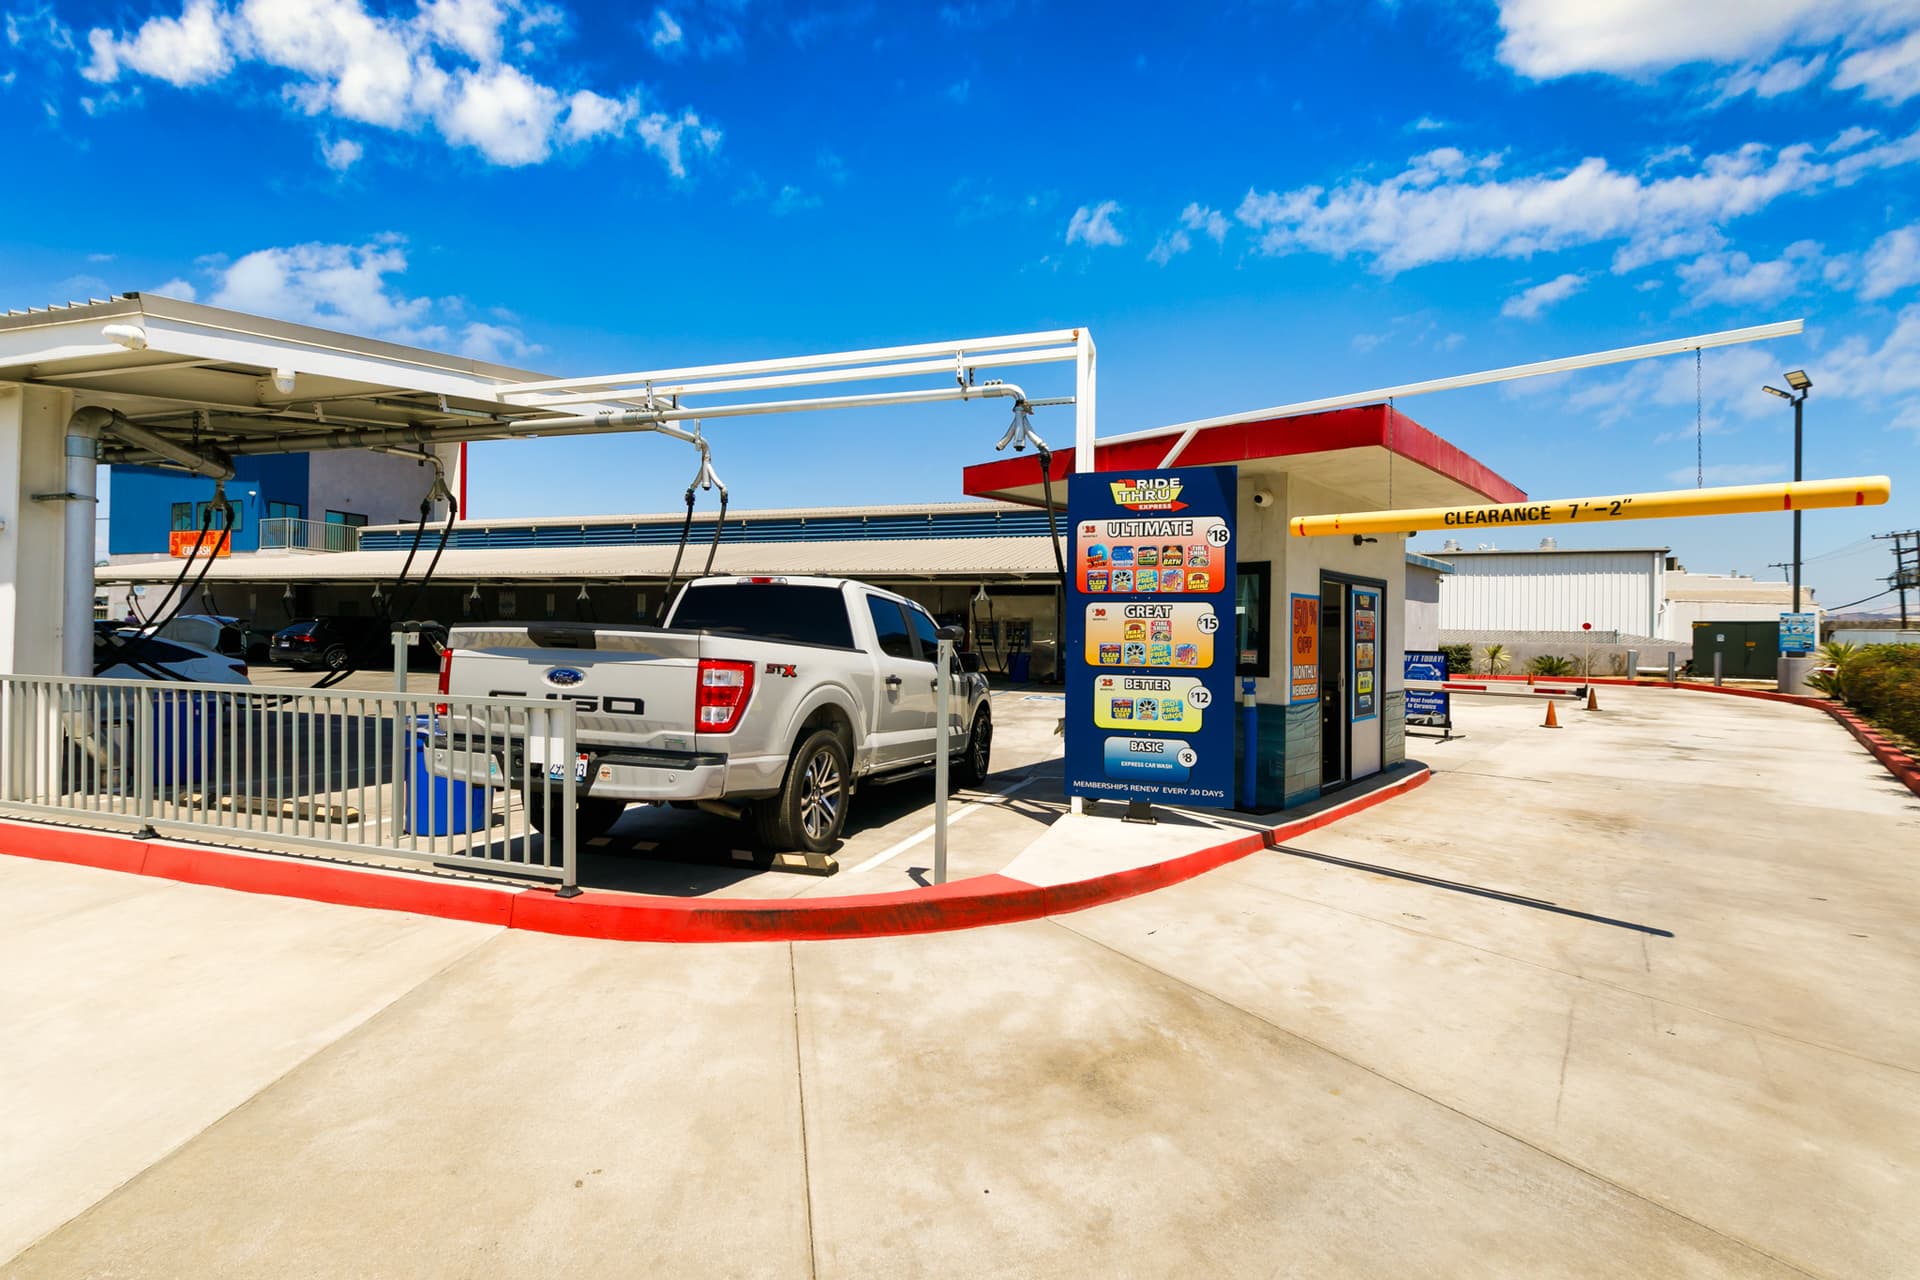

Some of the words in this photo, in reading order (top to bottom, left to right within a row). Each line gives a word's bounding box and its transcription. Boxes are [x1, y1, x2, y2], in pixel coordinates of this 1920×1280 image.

[1136, 478, 1182, 490] RIDE
[1118, 489, 1171, 502] THRU
[1444, 505, 1551, 525] CLEARANCE
[1106, 519, 1193, 538] ULTIMATE
[1207, 529, 1229, 543] $18
[170, 531, 179, 556] 5
[1124, 604, 1173, 619] GREAT
[1198, 618, 1217, 630] $15
[1297, 636, 1312, 654] OFF
[1421, 655, 1444, 663] TODAY!
[765, 663, 797, 678] STX
[1293, 665, 1317, 679] MONTHLY
[1124, 678, 1171, 691] BETTER
[1191, 692, 1209, 704] $12
[1129, 740, 1164, 753] BASIC
[1120, 760, 1144, 768] EXPRESS
[1182, 753, 1192, 763] $8
[1073, 780, 1129, 791] MEMBERSHIPS
[1130, 784, 1160, 793] RENEW
[1162, 787, 1189, 795] EVERY
[1189, 788, 1201, 796] 30
[1201, 789, 1225, 798] DAYS
